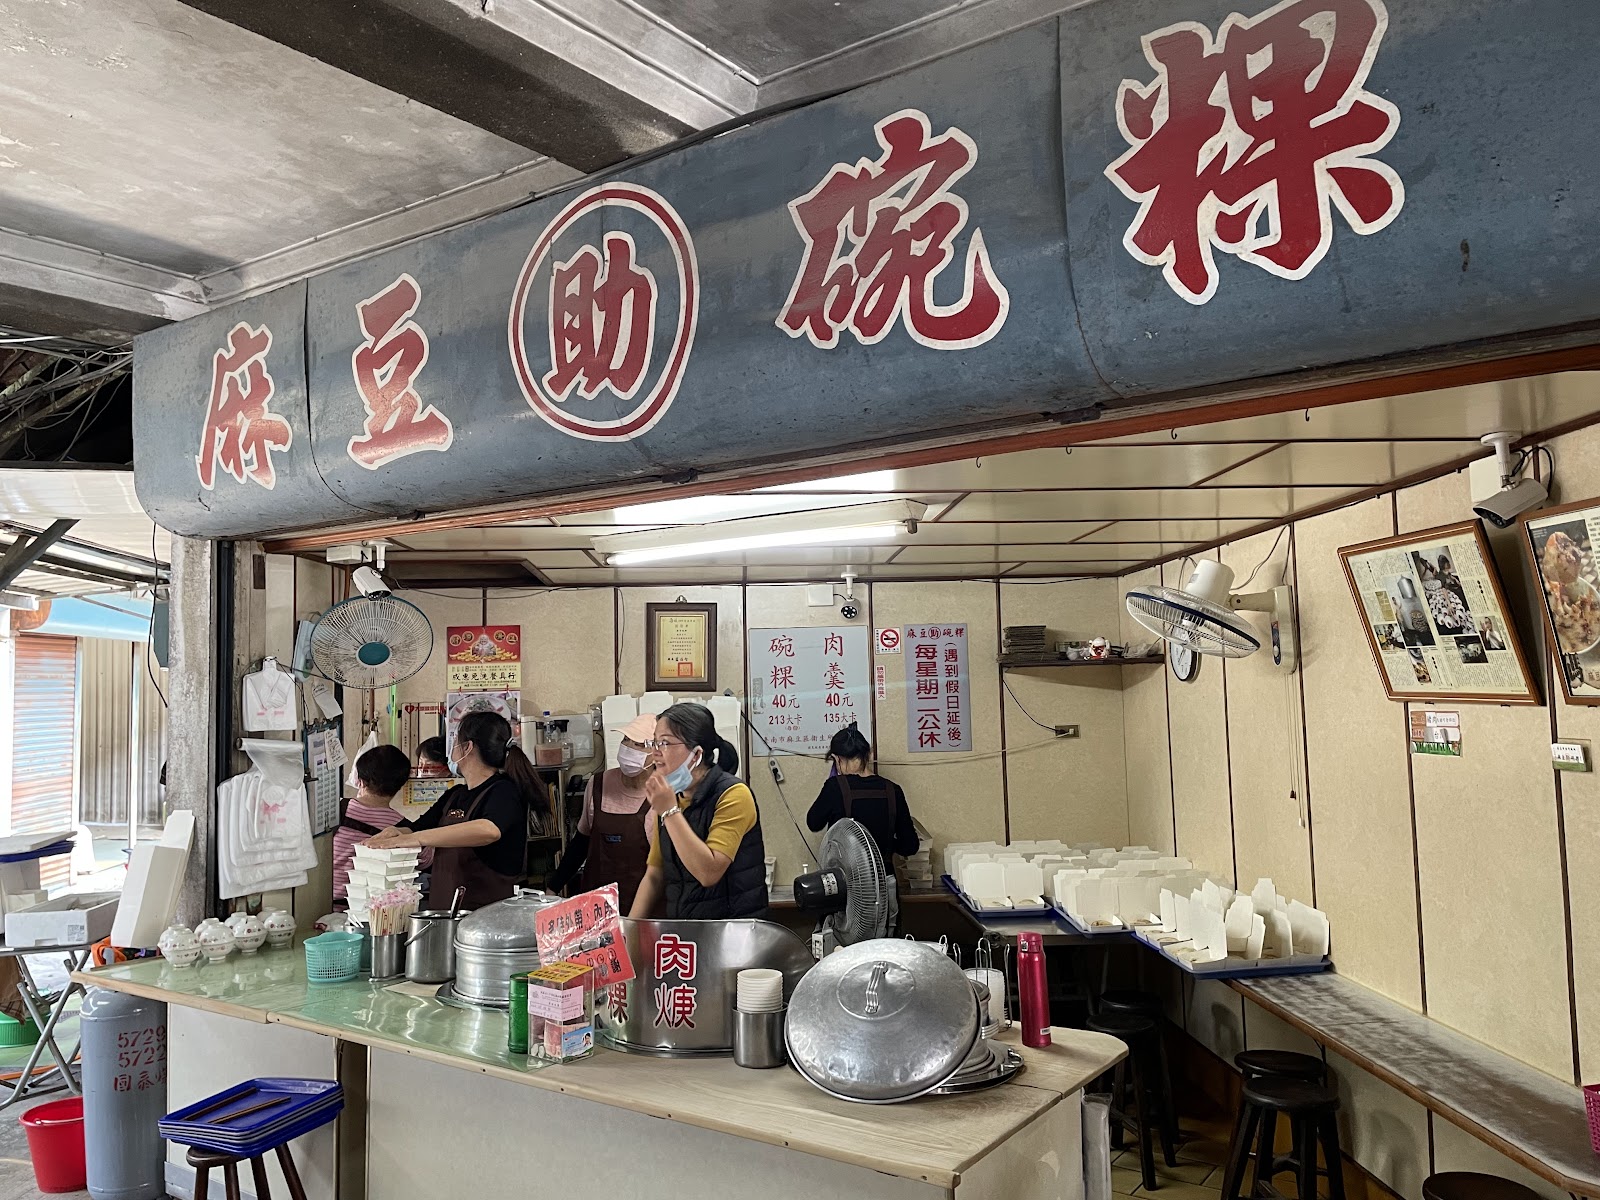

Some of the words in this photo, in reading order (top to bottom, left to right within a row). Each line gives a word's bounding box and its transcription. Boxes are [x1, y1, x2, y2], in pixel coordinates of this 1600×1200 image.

[768, 634, 796, 690] 碗粿
[823, 632, 845, 690] 肉羹
[772, 694, 800, 709] 40元
[825, 692, 854, 707] 40元
[915, 644, 942, 748] 每星期二公休
[768, 713, 803, 725] 213大卡
[823, 711, 857, 723] 135大卡
